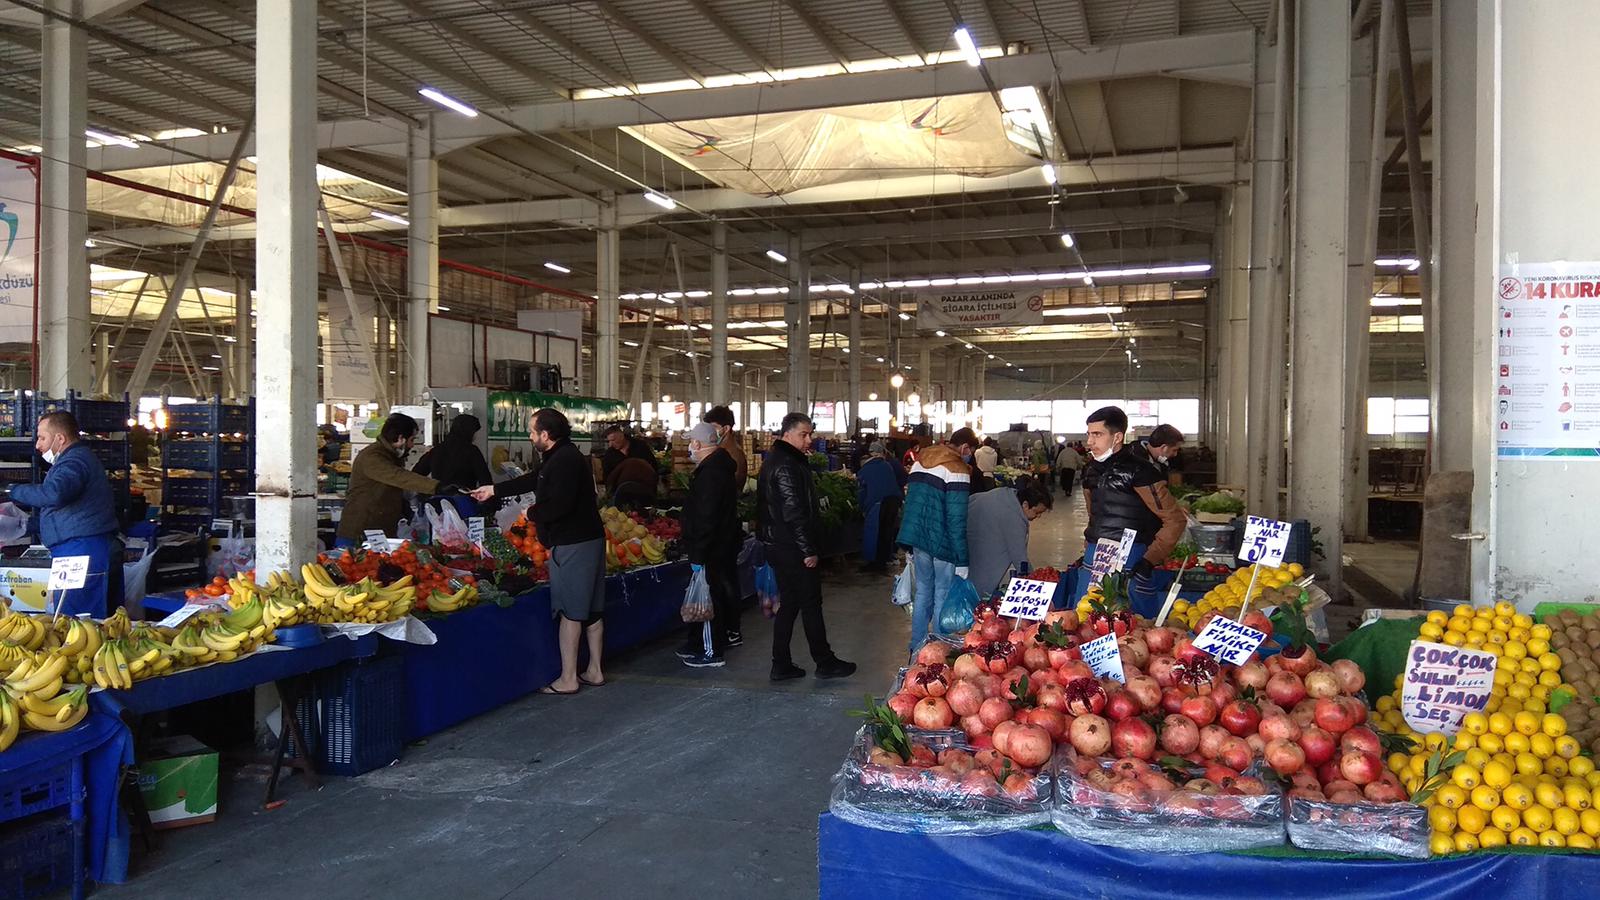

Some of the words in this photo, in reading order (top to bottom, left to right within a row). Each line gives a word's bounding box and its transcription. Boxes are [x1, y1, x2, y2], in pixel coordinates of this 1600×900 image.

[0, 274, 33, 289] düzü
[941, 295, 969, 303] PAZAR
[970, 292, 1015, 301] ALANINDA
[1524, 282, 1547, 300] 14
[943, 304, 976, 313] SİGARA
[977, 302, 1017, 312] İÇİLMESİ
[959, 313, 1001, 322] YASAKTIR
[1249, 516, 1287, 532] TATLI
[1258, 528, 1279, 539] NAR
[1247, 536, 1268, 563] 5
[1005, 595, 1050, 607] DEPOSU
[1008, 606, 1039, 617] NAR
[1211, 617, 1265, 643] ANTALYA
[1081, 635, 1114, 652] ANTALYA
[1205, 628, 1256, 652] FİNİKE
[1202, 643, 1240, 661] NAR
[1412, 646, 1458, 668] ÇOK
[1458, 654, 1495, 675] ÇOK
